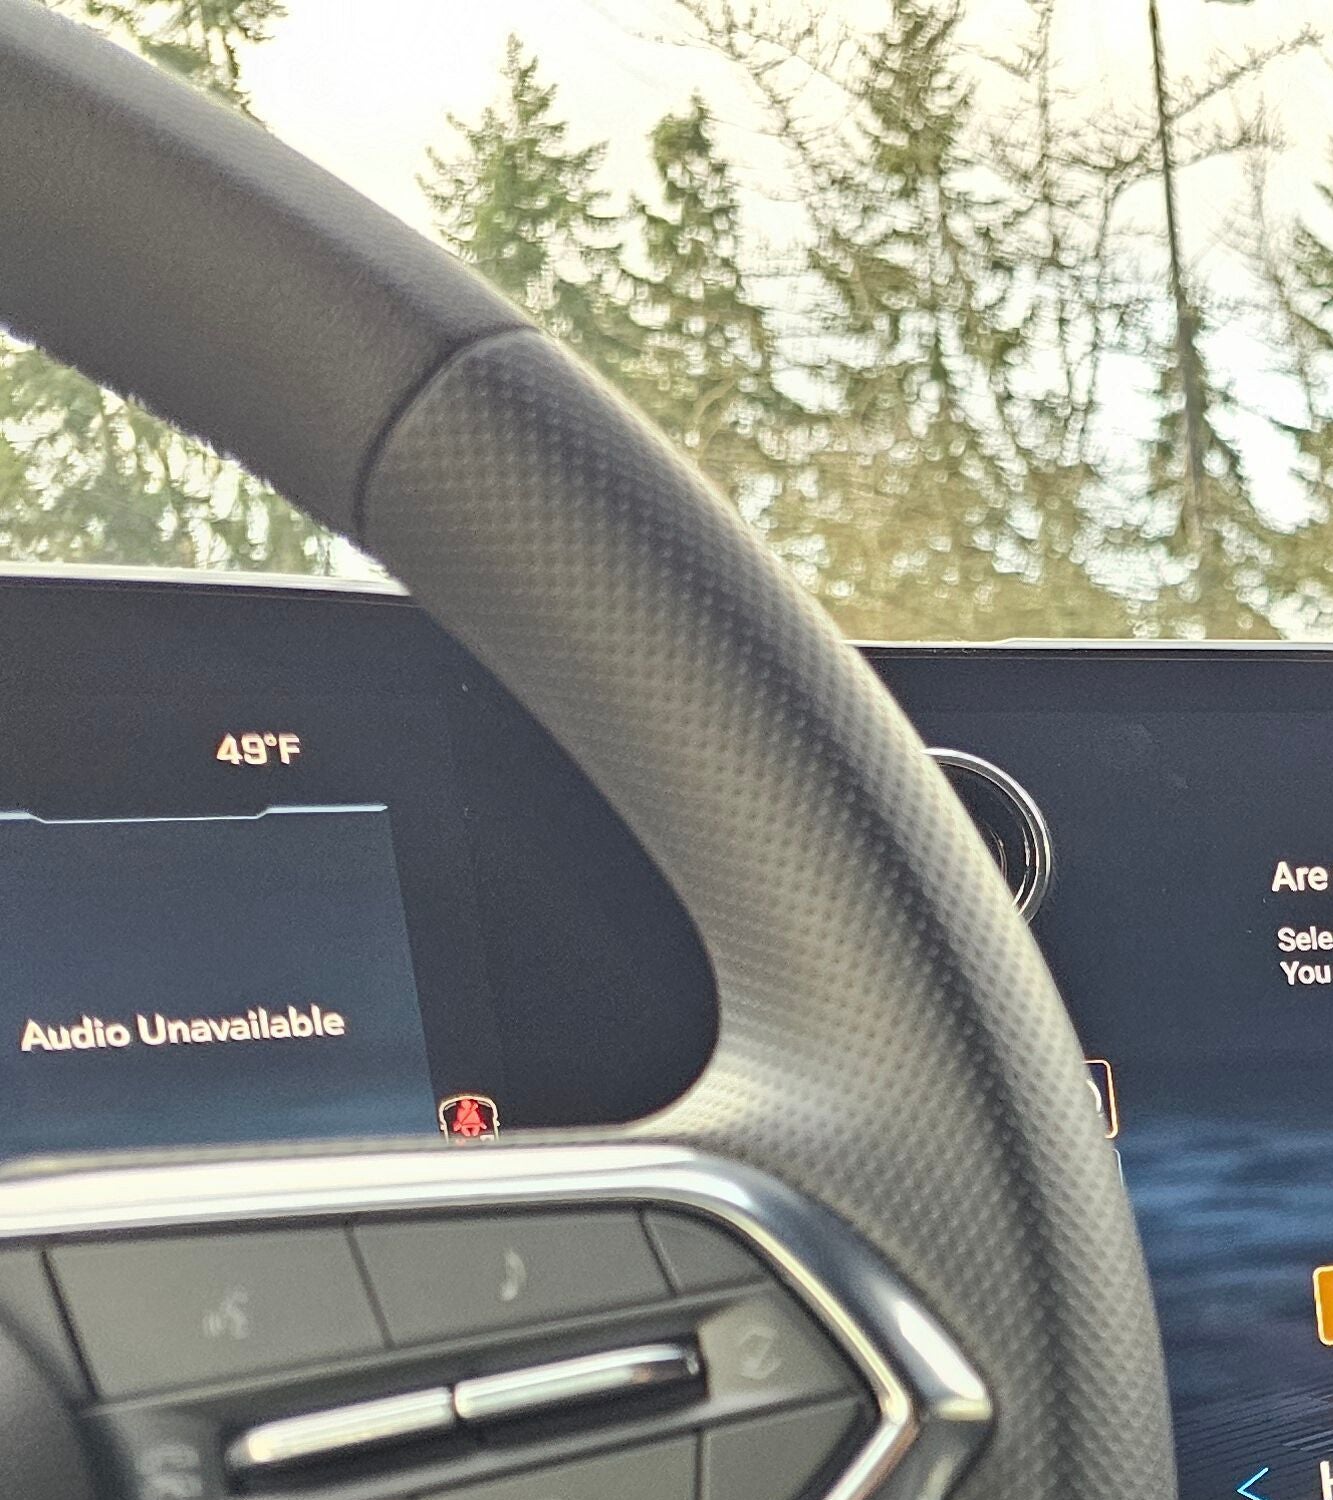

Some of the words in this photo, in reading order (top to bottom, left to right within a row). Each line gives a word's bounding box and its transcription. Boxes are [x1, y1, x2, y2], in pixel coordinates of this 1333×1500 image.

[215, 732, 302, 766] 49°F
[1271, 860, 1329, 893] Are
[1279, 960, 1332, 986] You
[20, 1013, 134, 1053] Audio
[136, 1002, 346, 1046] Unavailable
